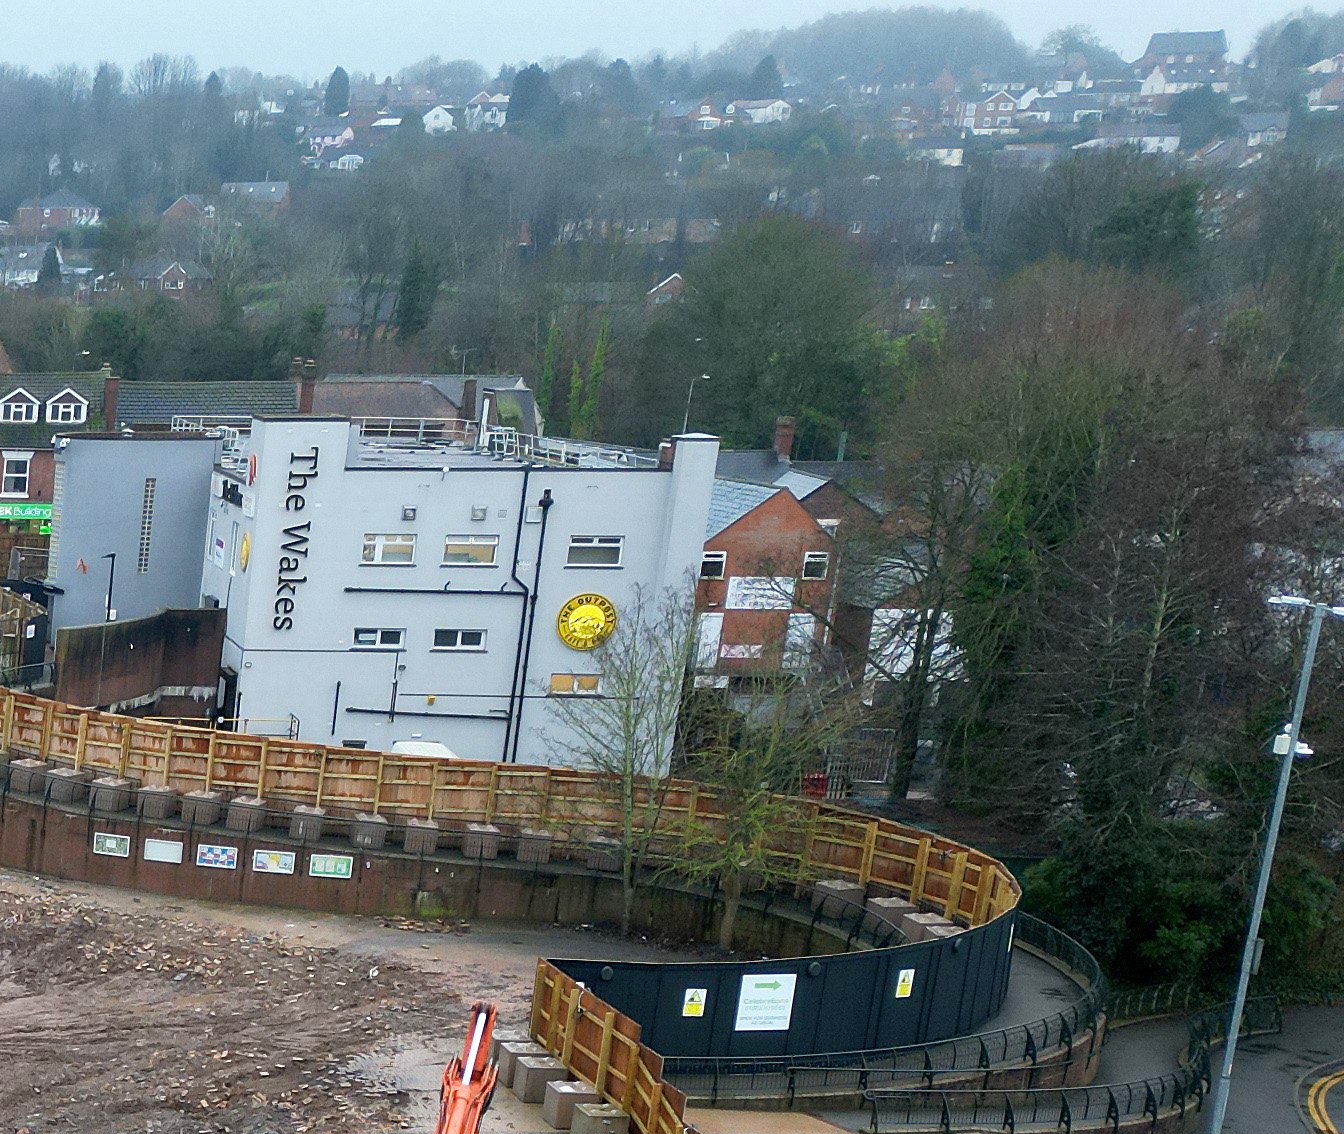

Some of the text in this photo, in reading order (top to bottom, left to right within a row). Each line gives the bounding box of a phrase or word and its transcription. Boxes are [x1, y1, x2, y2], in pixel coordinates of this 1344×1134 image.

[14, 507, 52, 518] Building
[273, 446, 319, 631] The Wakes
[560, 596, 616, 625] THE OUTPOST
